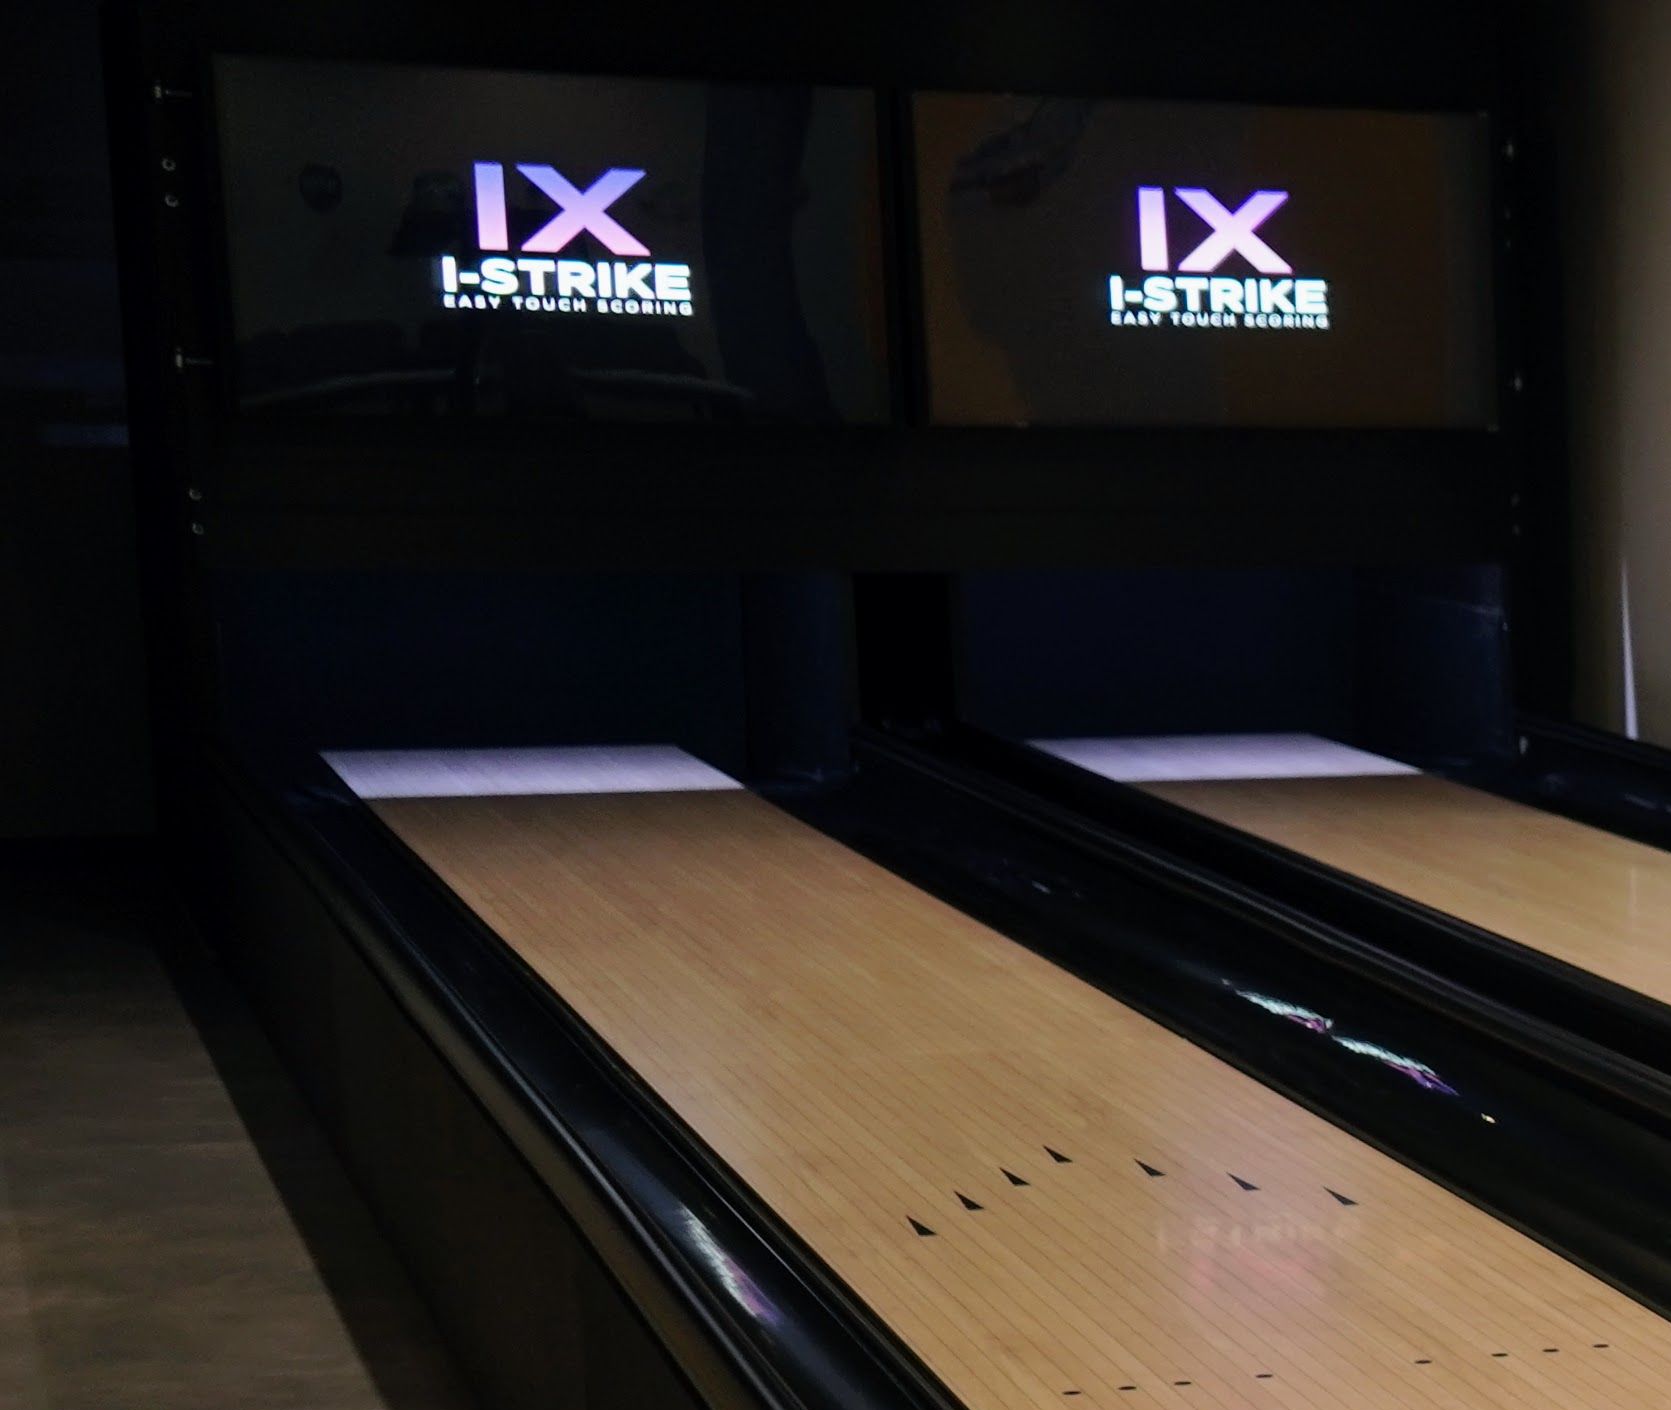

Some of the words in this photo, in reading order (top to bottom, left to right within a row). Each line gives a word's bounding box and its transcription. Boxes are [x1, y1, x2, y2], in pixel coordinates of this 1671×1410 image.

[473, 161, 651, 256] IX
[1137, 185, 1292, 274] IX
[441, 256, 692, 301] I-STRIKE
[1109, 274, 1328, 314] I-STRIKE
[443, 294, 501, 310] EASY
[512, 296, 587, 313] TOUCH
[597, 298, 693, 317] SCORING
[1110, 311, 1162, 326] EASY
[1170, 311, 1236, 328] TOUCH
[1244, 312, 1329, 330] SCORING
